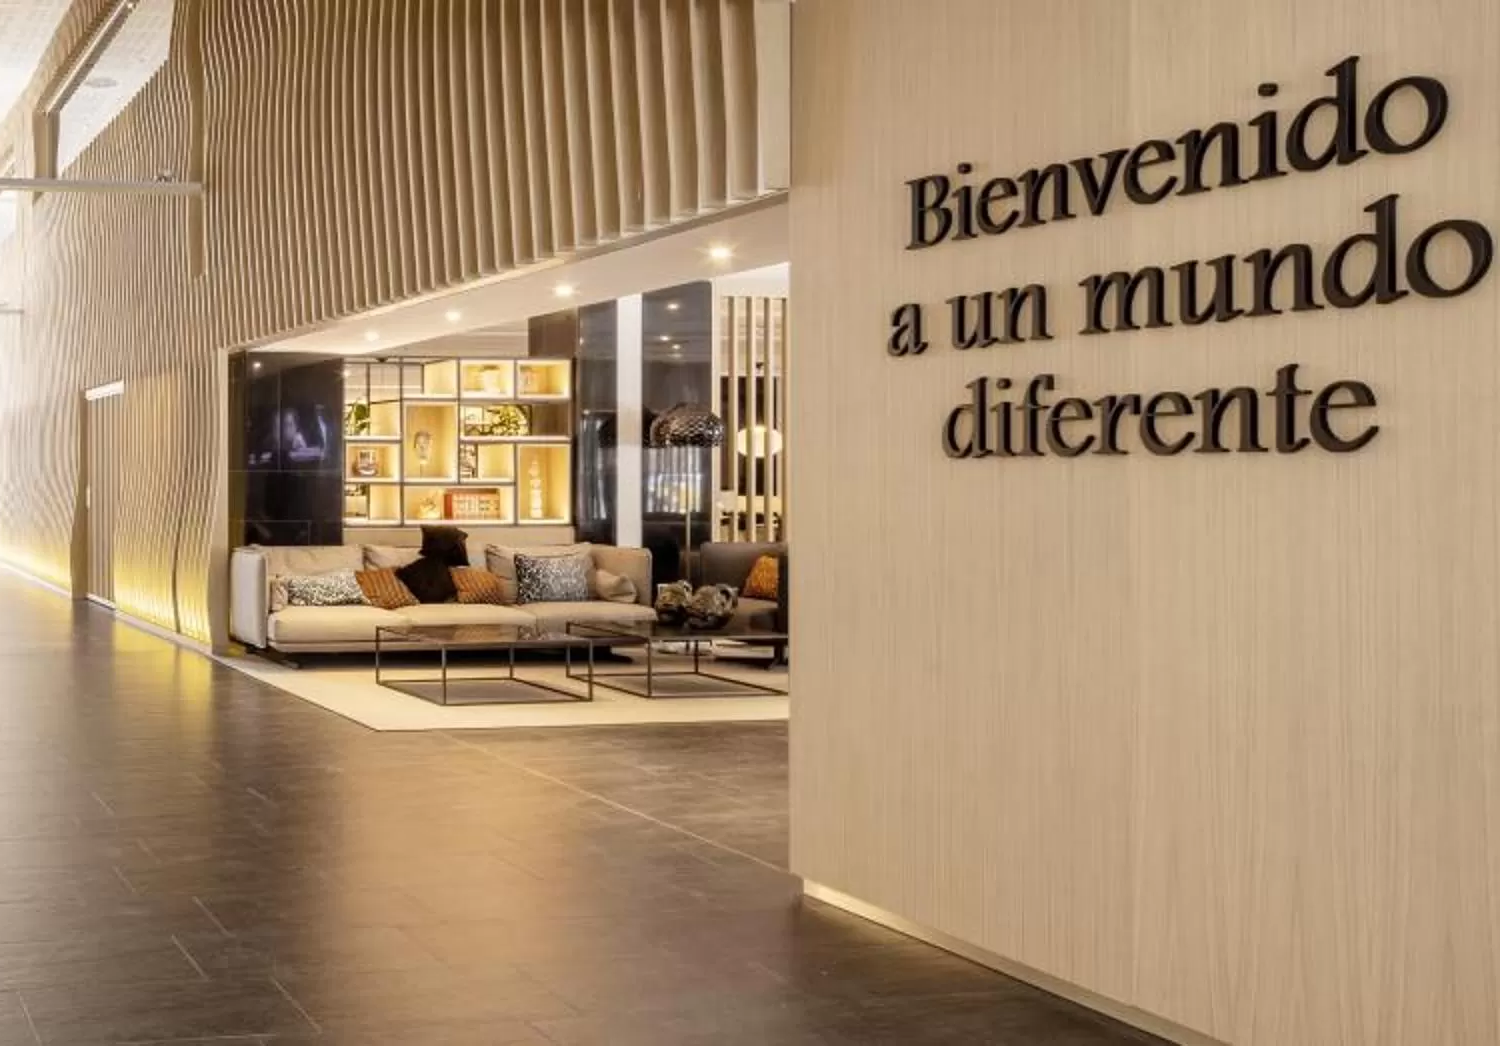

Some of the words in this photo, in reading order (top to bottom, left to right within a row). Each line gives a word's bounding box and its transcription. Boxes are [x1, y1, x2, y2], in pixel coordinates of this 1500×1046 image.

[904, 55, 1450, 251] Bienvenido
[887, 303, 930, 357] a
[946, 280, 1054, 351] un
[1078, 193, 1494, 336] mundo
[941, 363, 1380, 459] diferente
